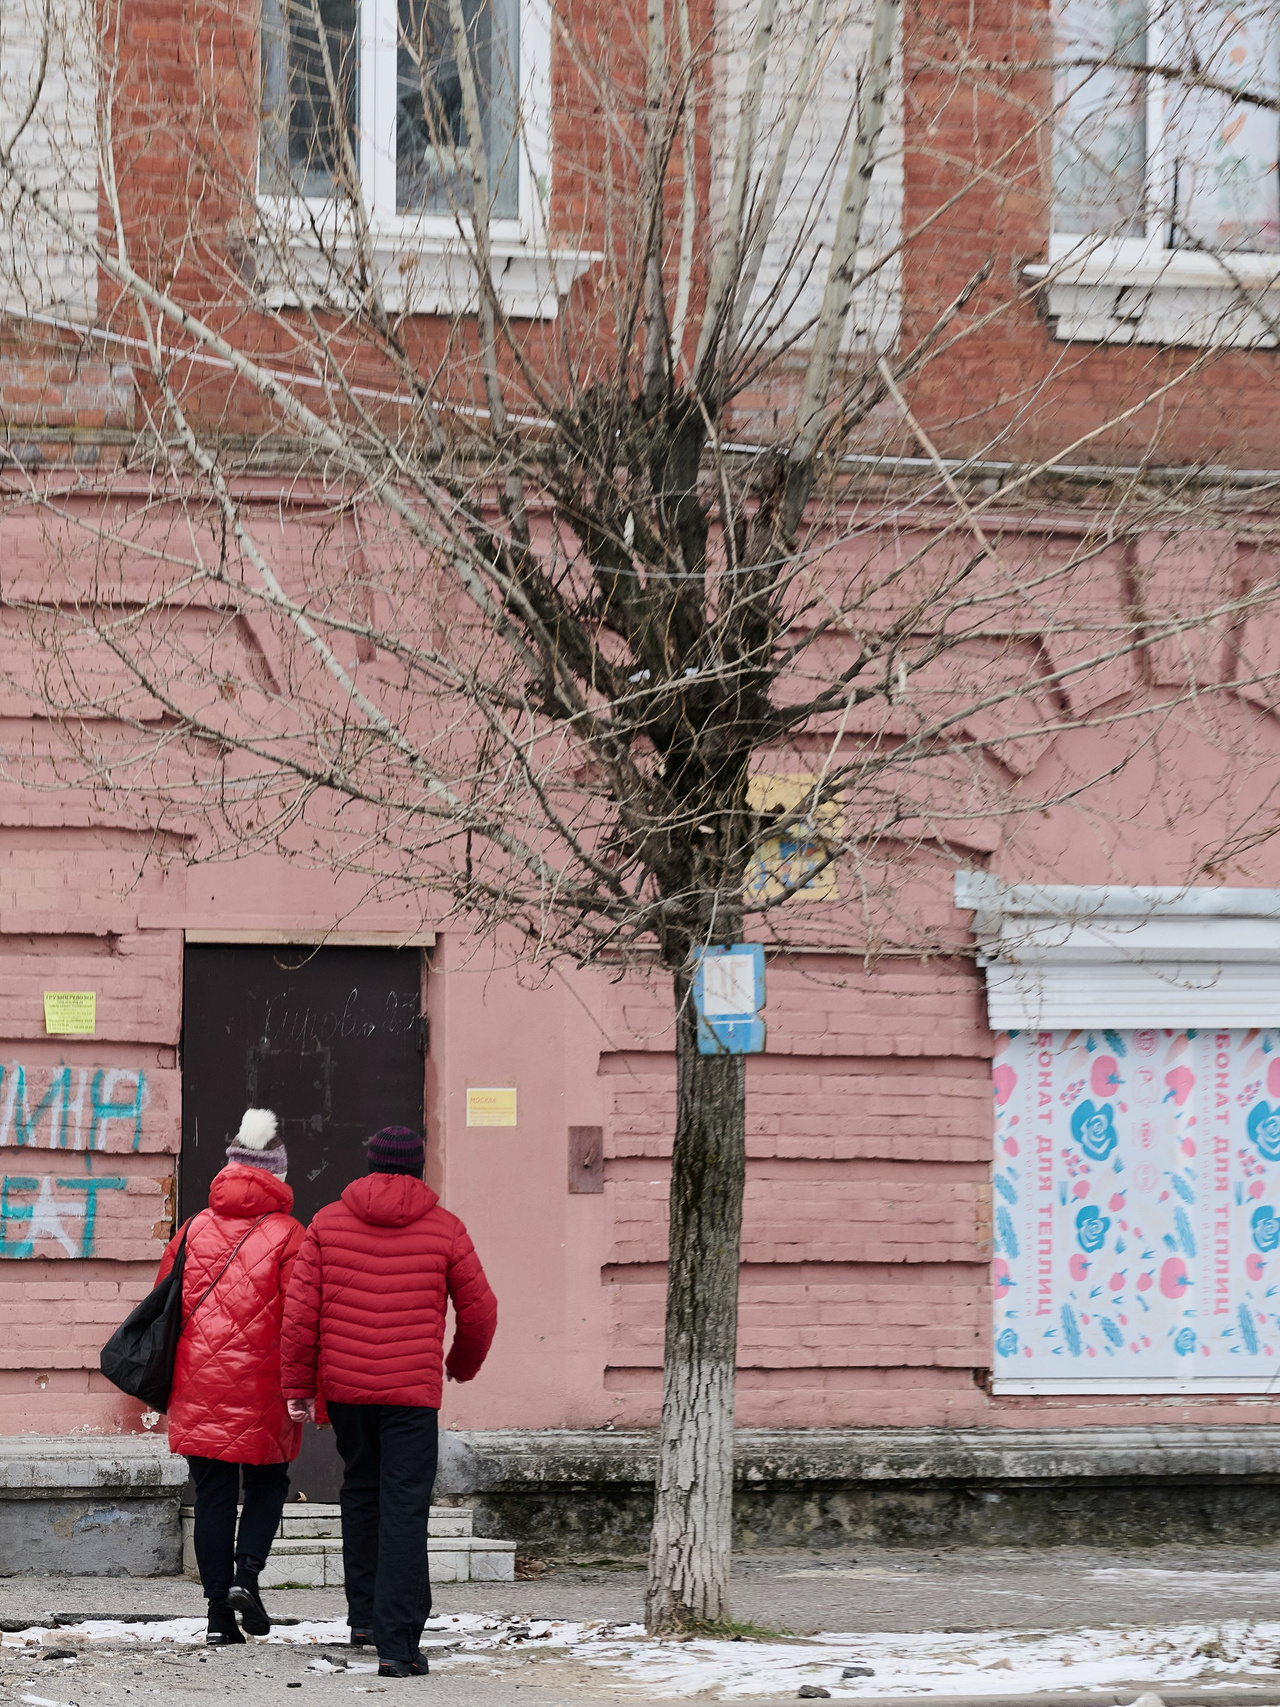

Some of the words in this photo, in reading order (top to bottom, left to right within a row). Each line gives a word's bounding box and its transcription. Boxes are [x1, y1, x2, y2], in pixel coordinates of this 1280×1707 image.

[1214, 1030, 1230, 1125] БОНАТ
[1036, 1135, 1054, 1191] ДЛЯ
[1213, 1135, 1230, 1191] ДЛЯ
[1035, 1203, 1054, 1316] ТЕПЛИЦ
[1213, 1203, 1230, 1315] ТЕПЛИЦ
